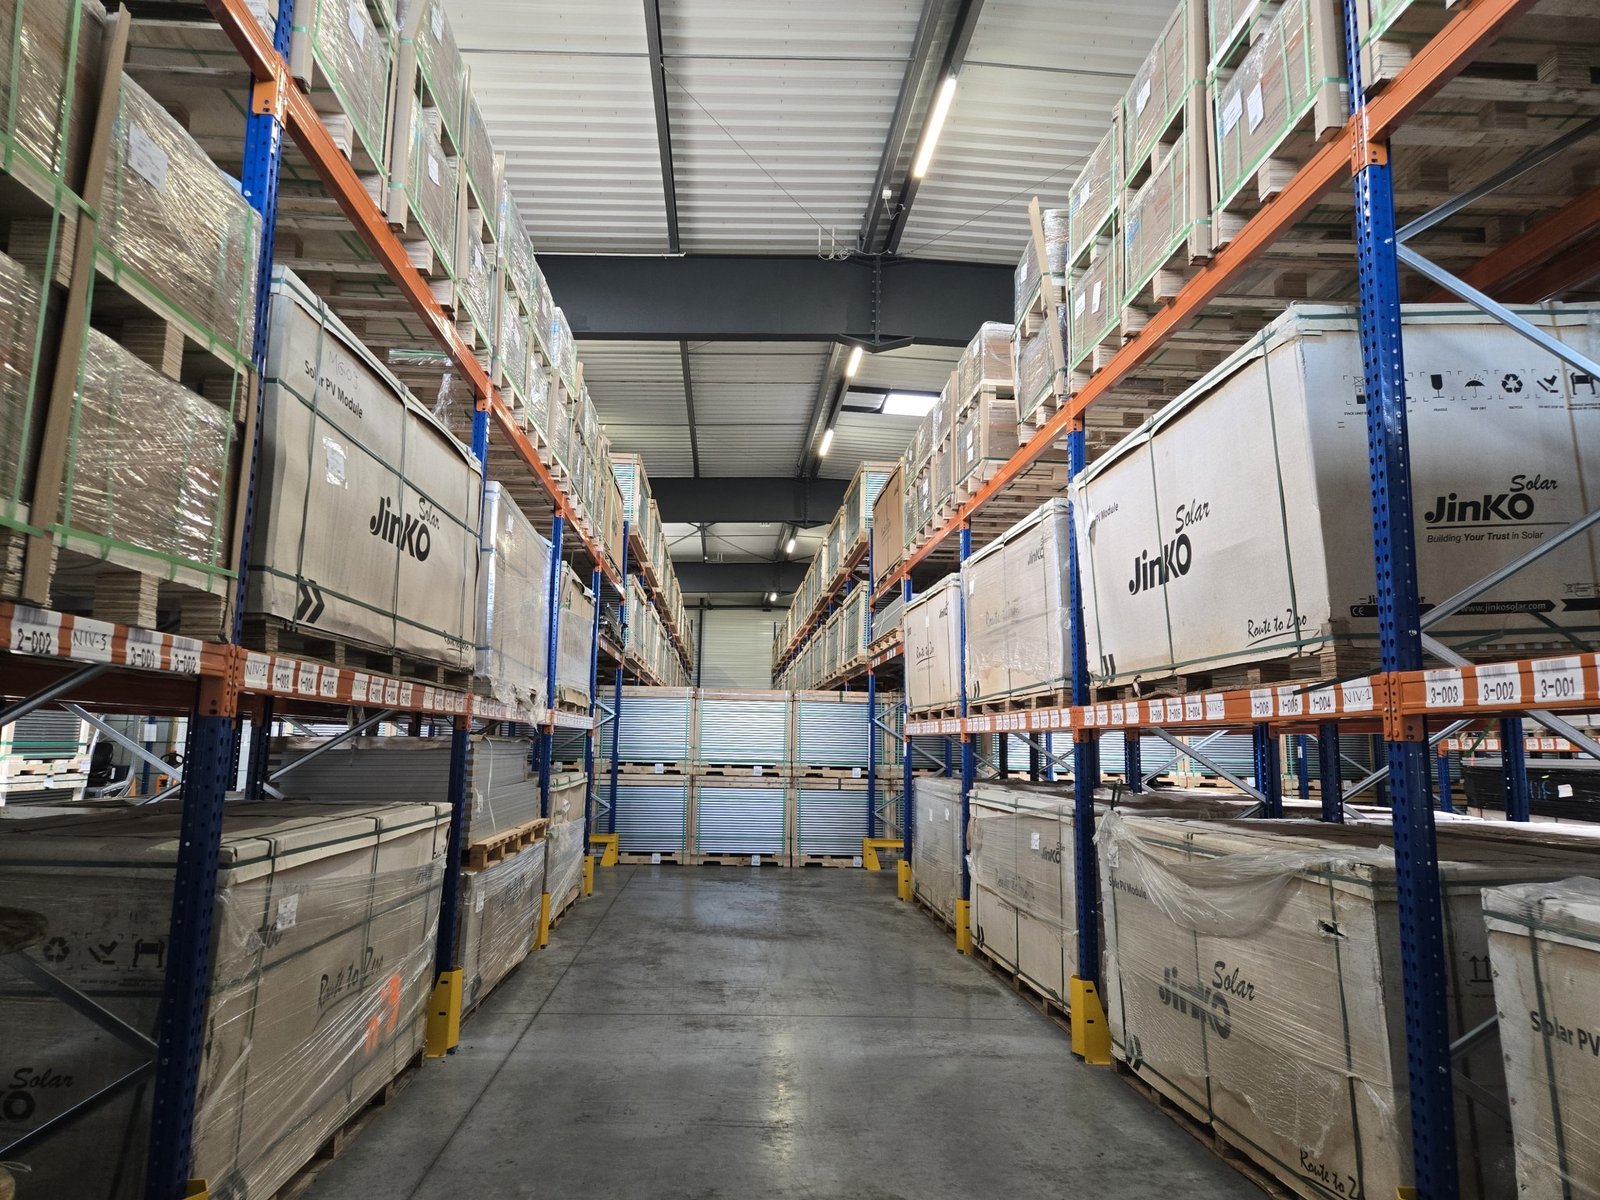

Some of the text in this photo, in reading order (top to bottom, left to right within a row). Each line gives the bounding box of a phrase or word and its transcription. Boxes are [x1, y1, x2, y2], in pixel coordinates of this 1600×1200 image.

[326, 377, 336, 396] PV
[337, 387, 363, 419] Module
[1509, 473, 1558, 492] Solar
[419, 497, 440, 530] Solar
[1175, 498, 1211, 534] Solar
[1424, 492, 1535, 523] JinKO
[370, 496, 431, 561] JinKO
[1427, 534, 1462, 543] Building
[1463, 533, 1484, 541] Your
[1487, 532, 1510, 540] Trust
[1521, 531, 1543, 539] Solar
[1128, 533, 1192, 596] JinKO
[1247, 608, 1307, 638] Route to Zro
[17, 628, 52, 654] 2-002
[73, 631, 107, 651] NIV-3
[130, 646, 156, 669] 3-001
[174, 653, 197, 674] 3-002
[1430, 685, 1459, 704] 3-003
[1483, 681, 1514, 701] 3-002
[1541, 676, 1575, 699] 3-001
[1312, 696, 1331, 710] 1-004
[1212, 960, 1256, 1001] Solar
[1530, 1010, 1600, 1057] Solar PV
[8, 1067, 74, 1090] Solar
[1300, 1148, 1330, 1183] Route
[1331, 1171, 1345, 1193] to
